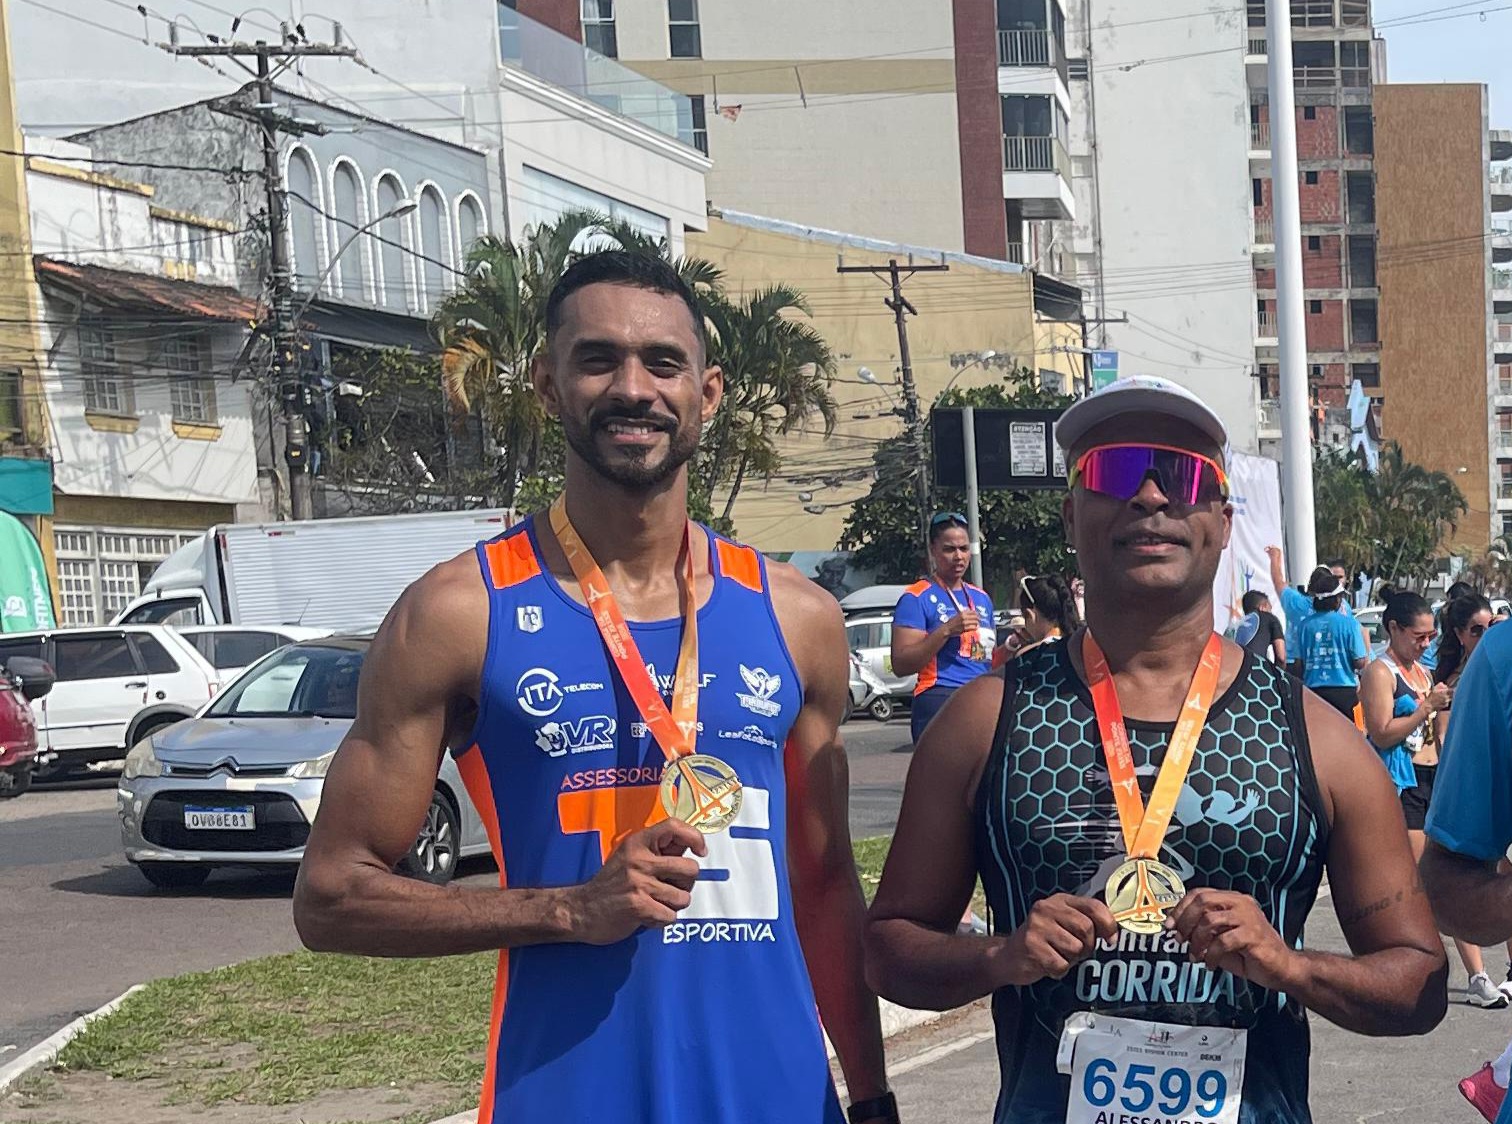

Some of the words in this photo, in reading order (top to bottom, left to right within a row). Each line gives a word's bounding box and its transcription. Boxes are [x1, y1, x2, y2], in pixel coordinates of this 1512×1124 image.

[525, 682, 564, 704] ITA
[663, 922, 776, 944] ESPORTIVA
[1075, 959, 1235, 1006] CORRIDA
[1083, 1058, 1228, 1118] 6599
